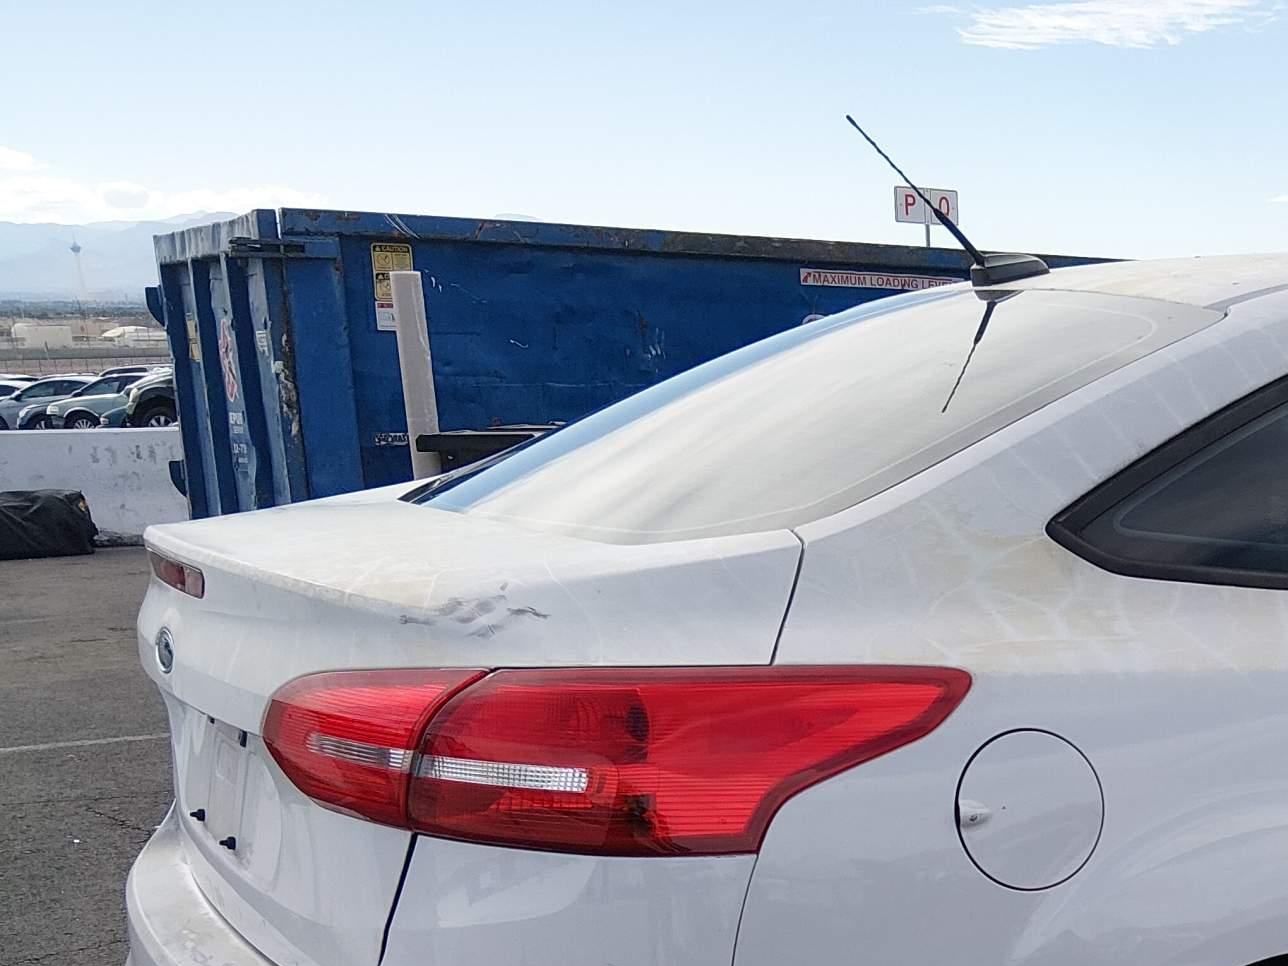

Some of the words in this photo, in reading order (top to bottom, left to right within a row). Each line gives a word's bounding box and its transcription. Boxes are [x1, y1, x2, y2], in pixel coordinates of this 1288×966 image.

[904, 194, 916, 216] P
[812, 273, 867, 287] MAXIMUM
[870, 276, 919, 290] LOADING
